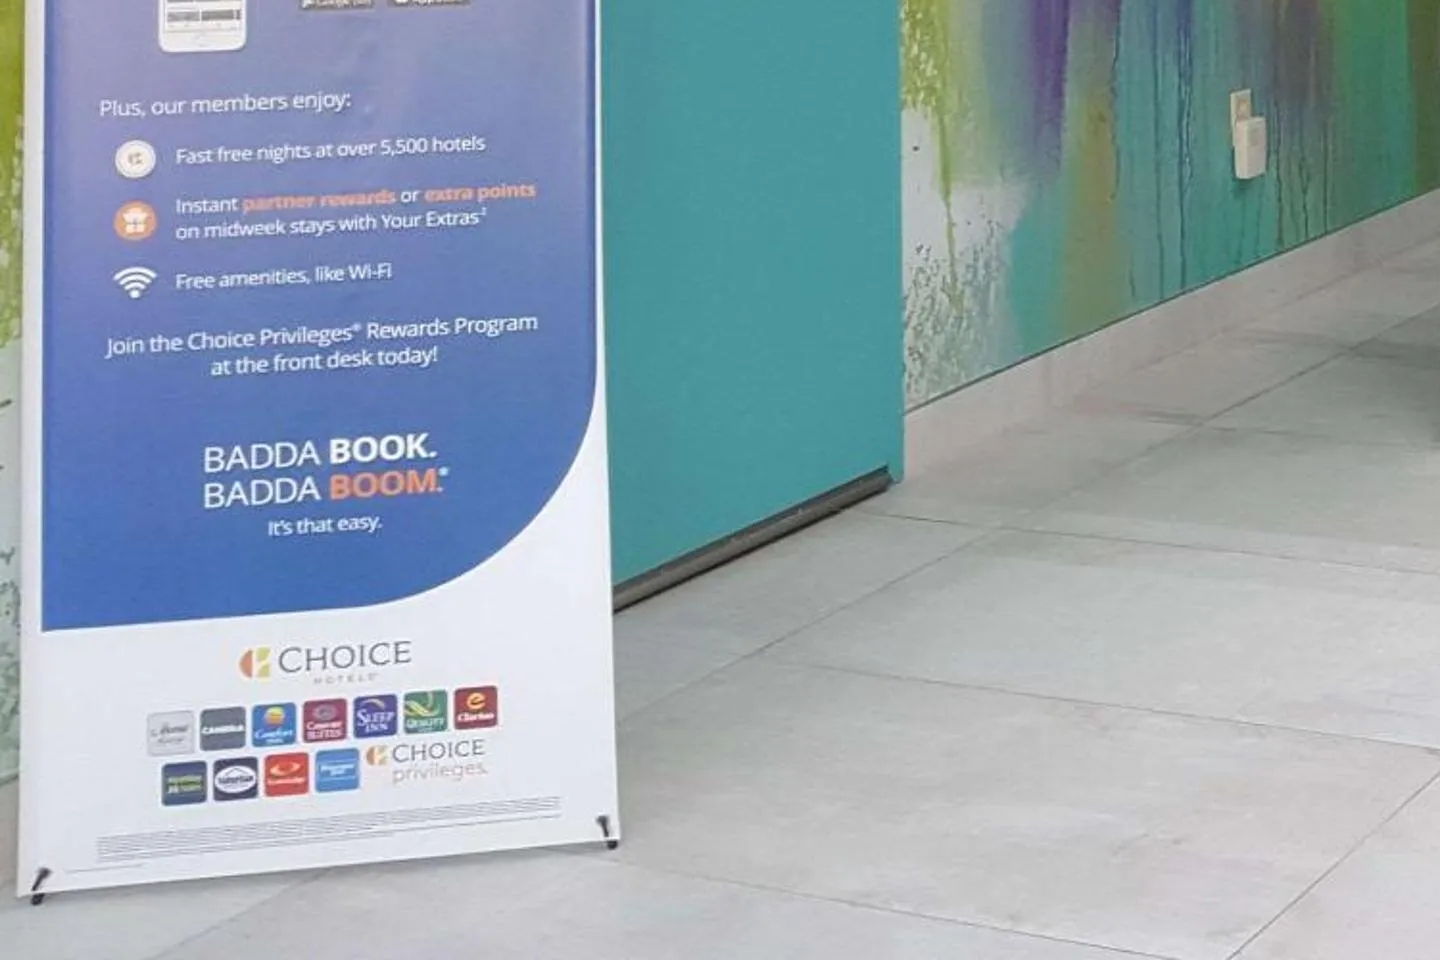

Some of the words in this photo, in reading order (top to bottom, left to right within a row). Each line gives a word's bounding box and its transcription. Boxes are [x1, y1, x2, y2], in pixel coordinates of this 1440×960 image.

[99, 98, 146, 118] Plus,
[151, 100, 186, 116] our
[191, 93, 289, 114] members
[292, 90, 352, 113] enjoy:
[176, 147, 213, 165] Fast
[217, 145, 253, 162] free
[256, 143, 311, 164] nights
[315, 142, 333, 158] at
[336, 141, 376, 158] over
[380, 137, 428, 157] 5,500
[431, 135, 486, 153] hotels
[176, 197, 239, 215] Instant
[243, 194, 316, 214] partner
[320, 189, 397, 208] rewards
[400, 189, 419, 204] or
[423, 186, 474, 204] extra
[477, 182, 537, 204] points
[175, 224, 200, 241] on
[204, 218, 286, 239] midweek
[289, 217, 336, 237] stays
[338, 211, 377, 231] with
[380, 211, 422, 230] Your
[176, 273, 214, 290] Free
[219, 268, 310, 289] amenities,
[314, 264, 345, 282] like
[349, 262, 392, 281] Wi-Fi
[104, 337, 145, 359] Join
[150, 334, 183, 353] the
[187, 329, 256, 352] Choice
[366, 317, 450, 340] Rewards
[453, 315, 539, 339] Program
[210, 357, 231, 376] at
[236, 355, 269, 375] the
[273, 352, 322, 373] front
[326, 349, 373, 370] desk
[377, 346, 438, 368] today!
[204, 442, 320, 473] BADDA
[329, 432, 437, 464] BOOK.
[204, 475, 320, 509] BADDA
[267, 518, 293, 537] It's
[297, 515, 333, 535] that
[337, 514, 383, 534] easy.
[278, 640, 413, 674] CHOICE
[392, 739, 486, 763] CHOICE
